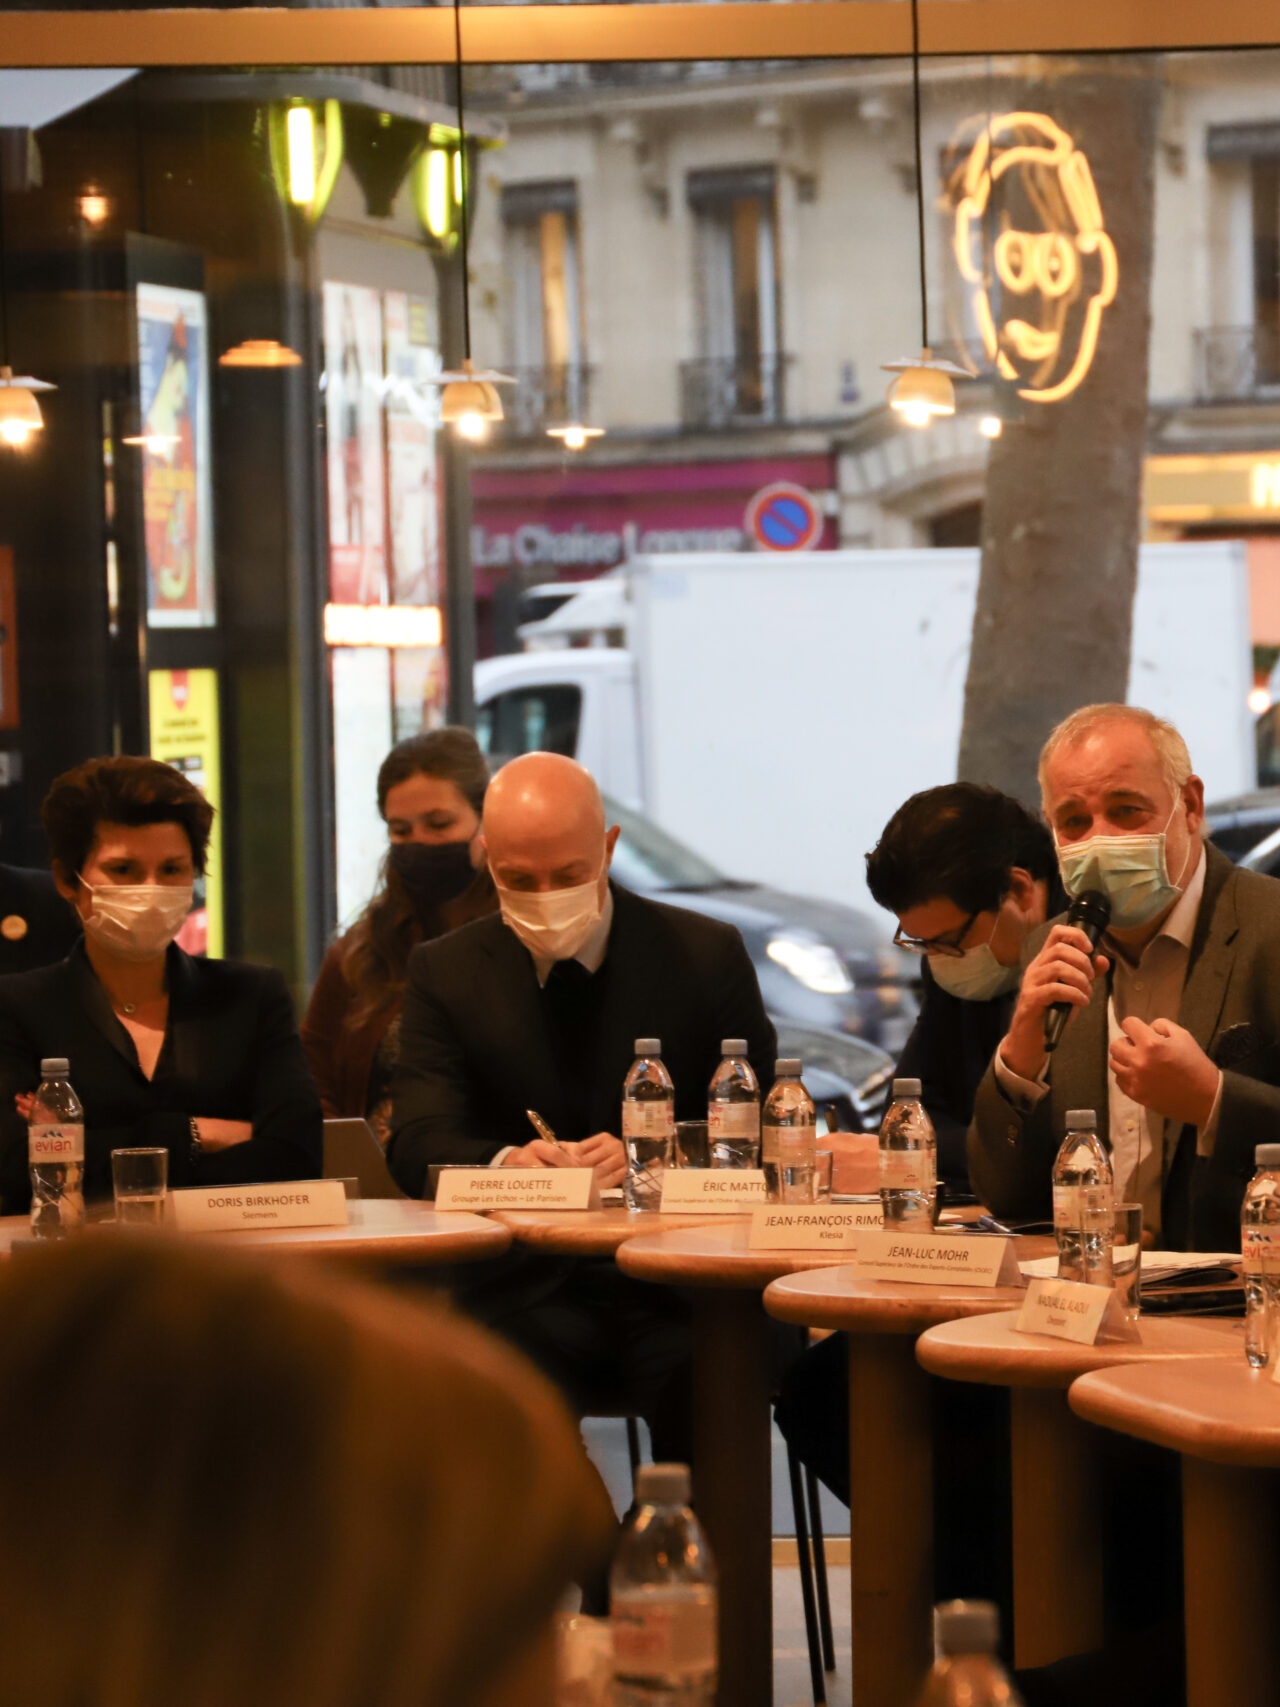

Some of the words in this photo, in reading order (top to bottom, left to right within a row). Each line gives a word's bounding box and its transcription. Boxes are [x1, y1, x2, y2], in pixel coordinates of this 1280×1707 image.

[471, 525, 510, 566] La
[35, 1139, 72, 1152] evian
[469, 1179, 504, 1190] PIERRE
[507, 1179, 552, 1190] LOUETTE
[703, 1179, 727, 1191] ÉRIC
[729, 1181, 769, 1192] MATTO
[207, 1197, 243, 1208] DORIS
[246, 1194, 310, 1207] BIRKHOFER
[241, 1211, 278, 1219] Siemens
[765, 1215, 853, 1228] JEAN-FRANÇOIS
[855, 1215, 885, 1225] RIMO
[819, 1231, 844, 1239] Klesia
[887, 1246, 935, 1259] JEAN-LUC
[936, 1249, 969, 1261] MOHR
